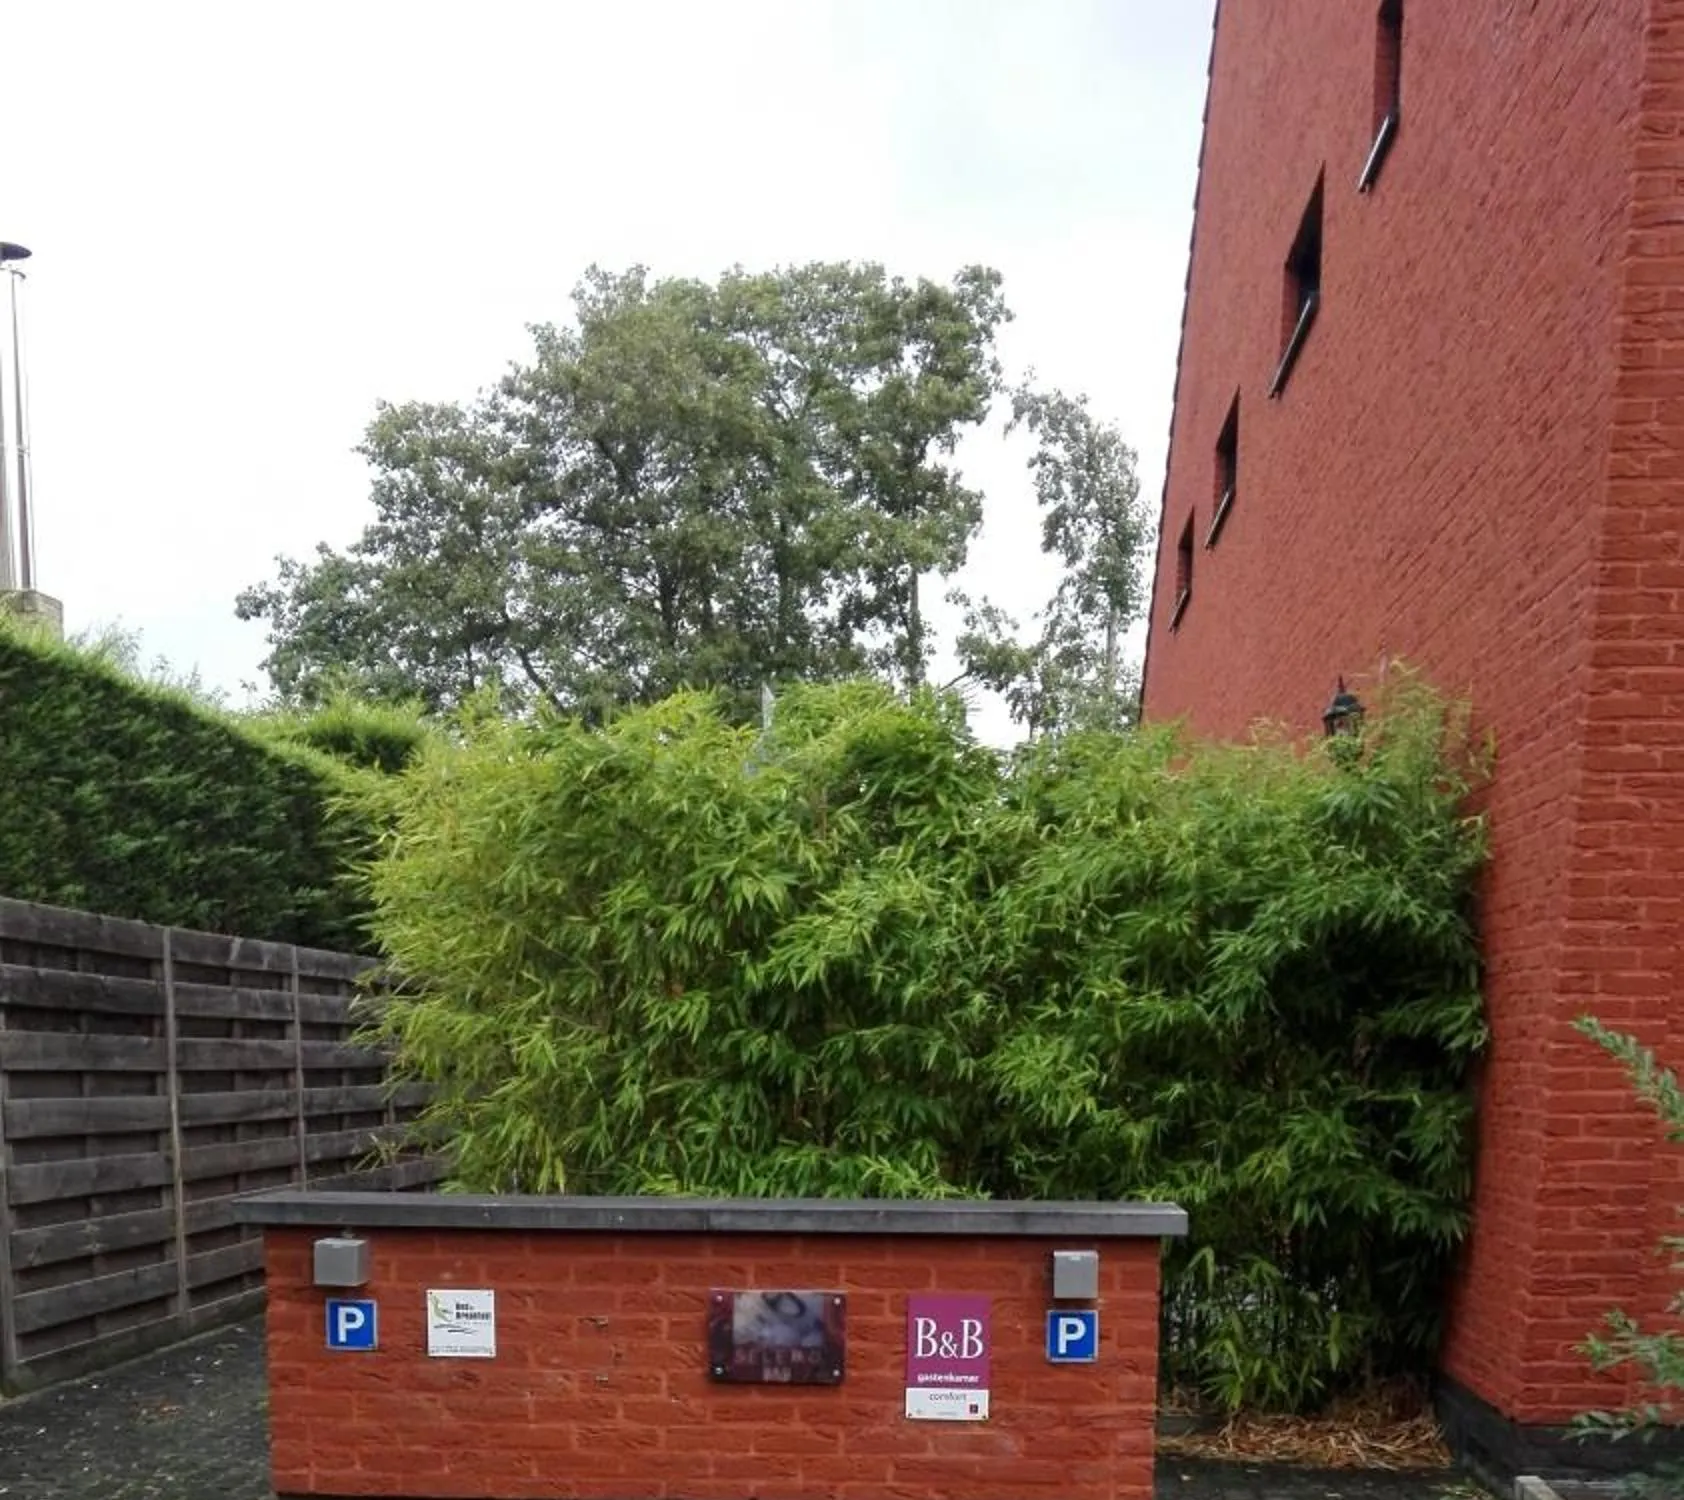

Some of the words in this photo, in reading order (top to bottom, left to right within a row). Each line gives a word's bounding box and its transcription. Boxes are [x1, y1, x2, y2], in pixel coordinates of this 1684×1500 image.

[338, 1306, 365, 1342] P
[914, 1317, 984, 1359] B&B
[1057, 1317, 1087, 1354] P
[928, 1391, 967, 1401] comfort
